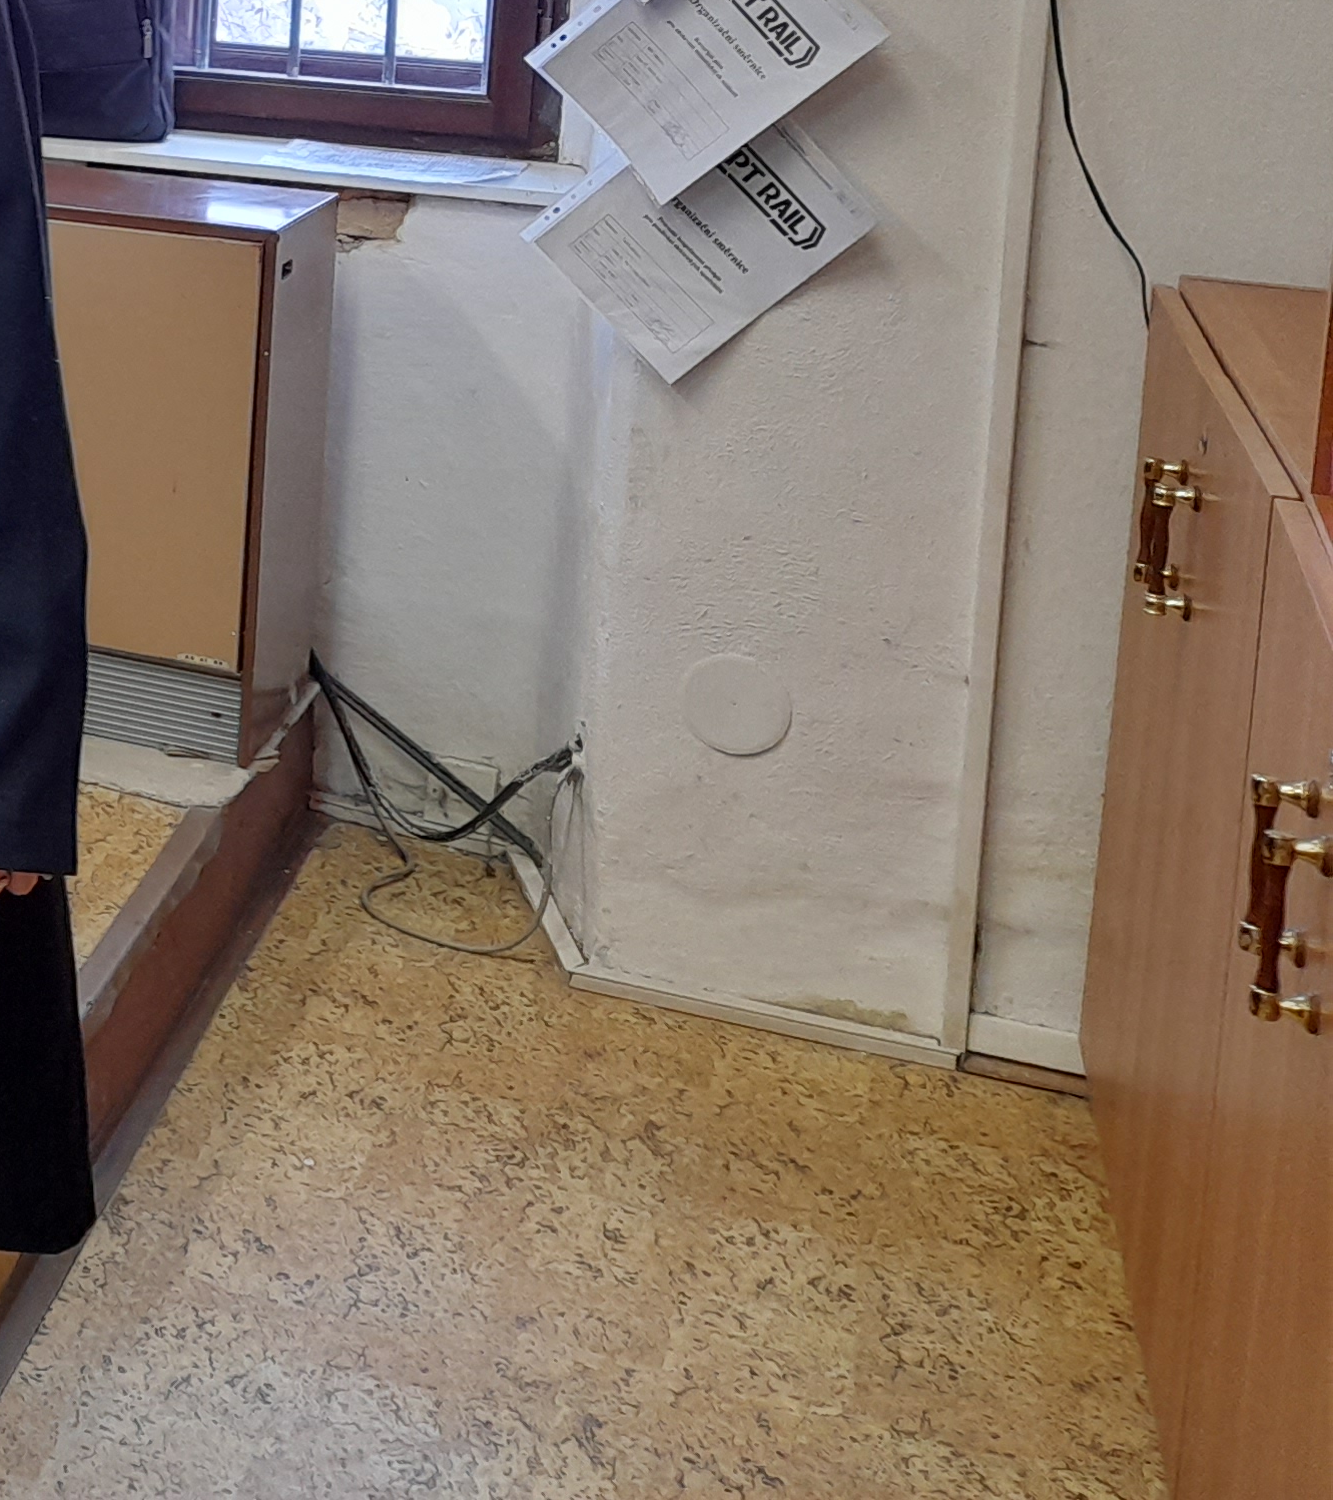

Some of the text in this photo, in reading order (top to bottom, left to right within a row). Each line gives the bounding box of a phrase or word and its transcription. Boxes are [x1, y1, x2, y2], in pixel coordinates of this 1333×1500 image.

[756, 5, 802, 56] RAIL
[671, 196, 717, 240] rganizační
[724, 150, 806, 236] PT RAIL
